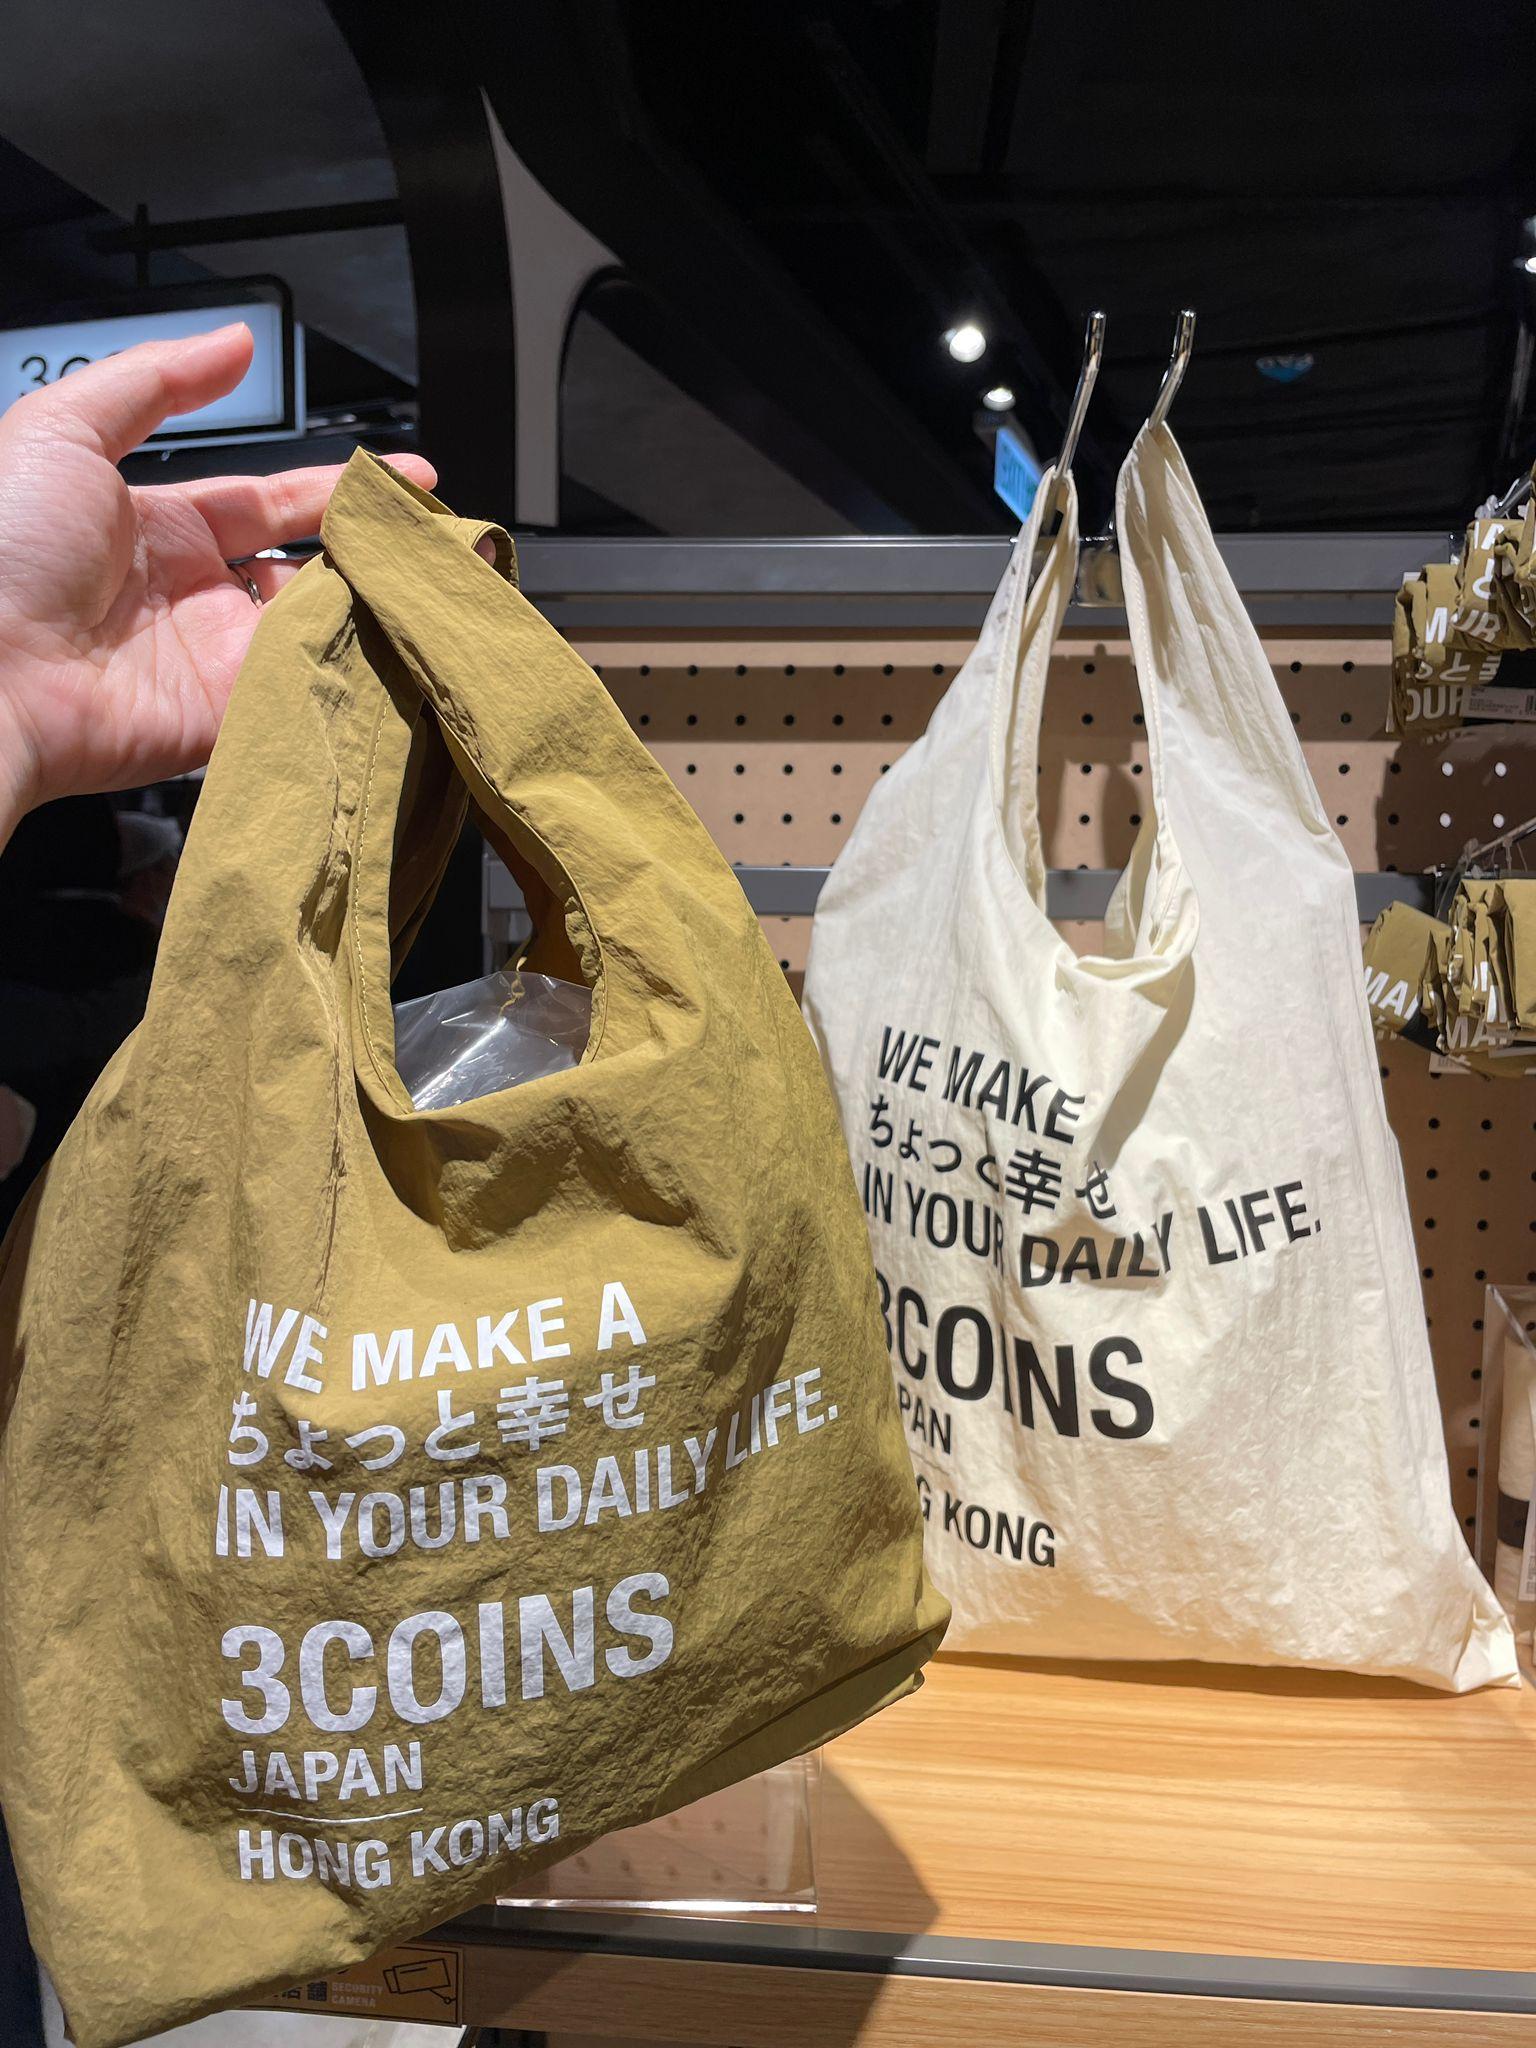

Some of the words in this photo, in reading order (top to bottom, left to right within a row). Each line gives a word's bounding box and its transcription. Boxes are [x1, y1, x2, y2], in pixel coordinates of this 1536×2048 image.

[878, 1026, 941, 1092] WE
[942, 1046, 1086, 1144] MAKE
[863, 1162, 893, 1224] IN
[905, 1180, 1004, 1277] YOUR
[1021, 1211, 1174, 1288] DAILY
[1197, 1181, 1321, 1265] LIFE.
[243, 1299, 327, 1393] WE
[352, 1298, 571, 1390] MAKE
[597, 1281, 646, 1351] A
[216, 1484, 284, 1558] IN
[309, 1474, 511, 1559] YOUR
[536, 1427, 717, 1532] DAILY
[724, 1368, 839, 1470] LIFE.
[228, 1366, 655, 1470] ちょっと幸せ
[898, 1383, 951, 1455] PAN
[944, 1491, 1055, 1568] KONG
[221, 1572, 674, 1734] 3COINS
[228, 1742, 423, 1801] JAPAN
[238, 1829, 391, 1890] HONG
[411, 1798, 560, 1877] KONG
[331, 1982, 384, 1995] SECURITY
[331, 1995, 377, 2008] CAMERA
